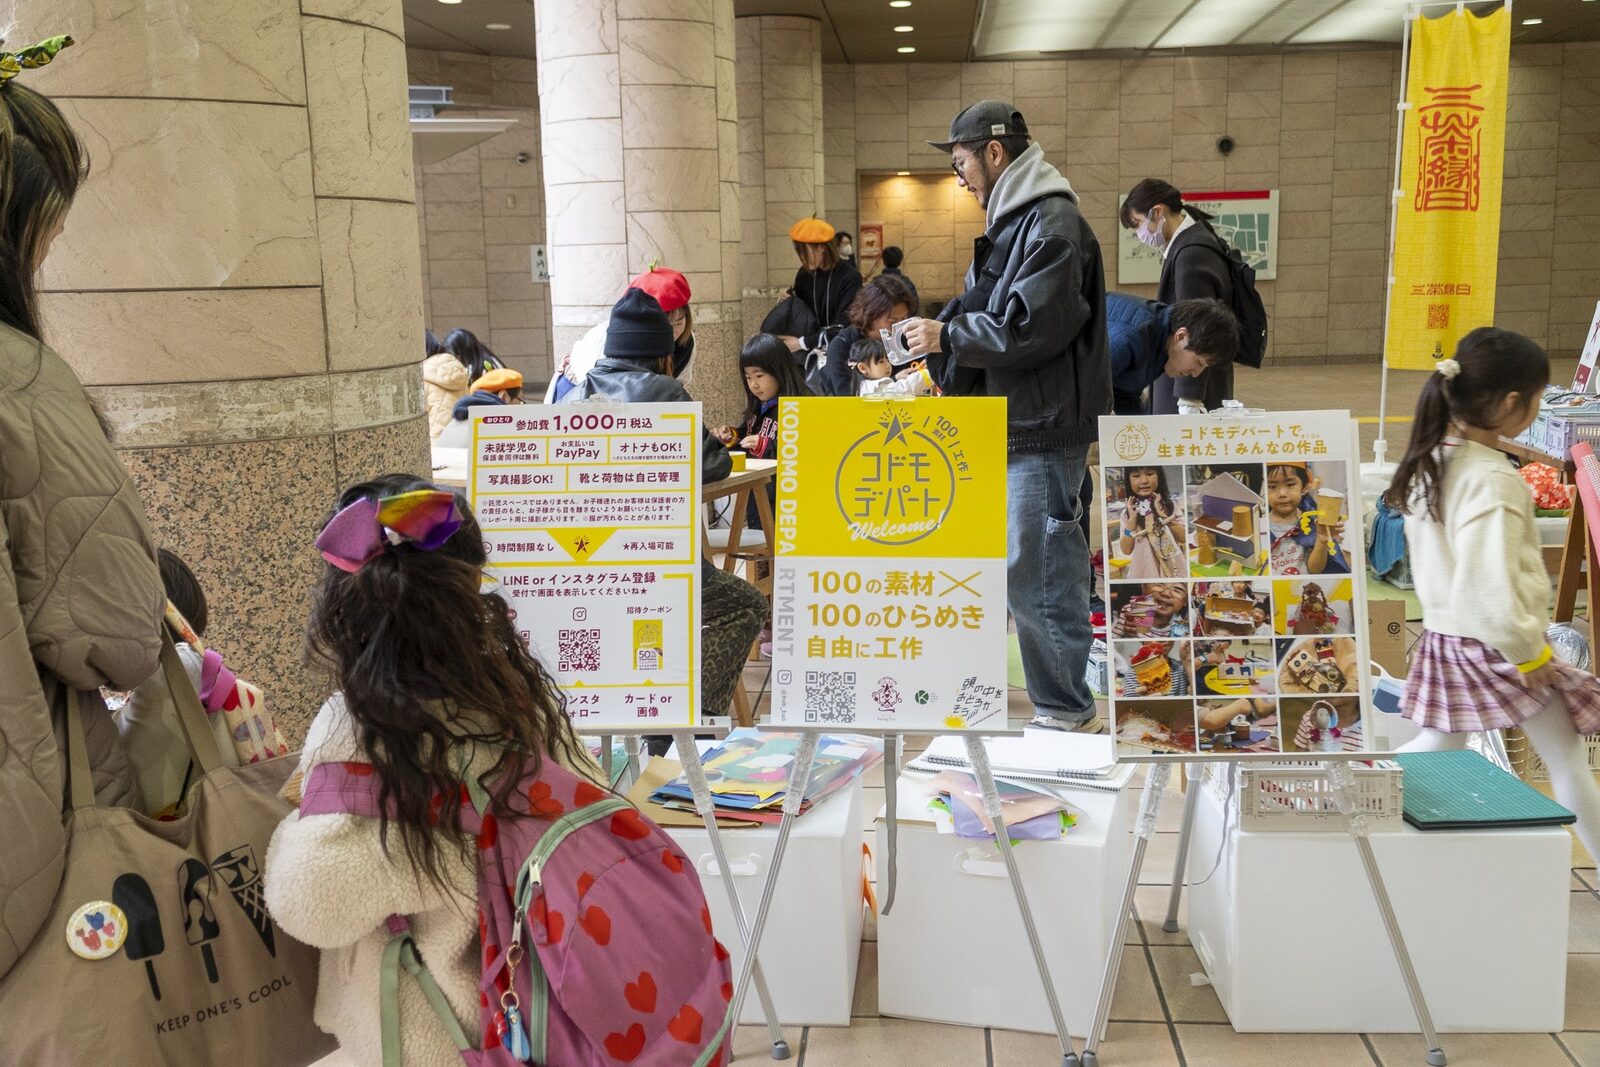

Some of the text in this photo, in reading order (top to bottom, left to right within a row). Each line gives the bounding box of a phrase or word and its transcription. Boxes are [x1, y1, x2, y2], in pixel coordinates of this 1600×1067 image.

[516, 419, 549, 431] 参加費
[630, 417, 653, 429] 税込
[936, 416, 959, 437] 100
[1181, 424, 1302, 440] コドモデパートで
[485, 442, 537, 453] 未就学児の
[556, 448, 600, 460] PayPay
[620, 443, 682, 453] オトナもOK!
[780, 401, 799, 493] KODOMO
[1157, 440, 1328, 458] 生まれた！みんなの作品
[862, 452, 930, 482] コドモ
[953, 450, 969, 472] 工作
[488, 475, 553, 485] 写真撮影OK!
[579, 472, 680, 484] 靴と荷物は自己管理
[854, 485, 940, 517] デパート
[848, 510, 945, 542] Welcome!
[497, 543, 554, 552] 時間制限なし
[503, 572, 656, 586] LINE or インスタグラム登録
[626, 606, 672, 614] 招待クーポン
[806, 604, 985, 629] 100のひらめき
[807, 635, 923, 660] 自由に工作
[961, 676, 1003, 698] 頭の中を
[569, 694, 600, 704] ンスタ
[625, 694, 672, 704] カード or
[569, 709, 600, 718] ォロー
[637, 707, 659, 717] 画像
[157, 976, 291, 1034] KEEP ONE'S COOL
